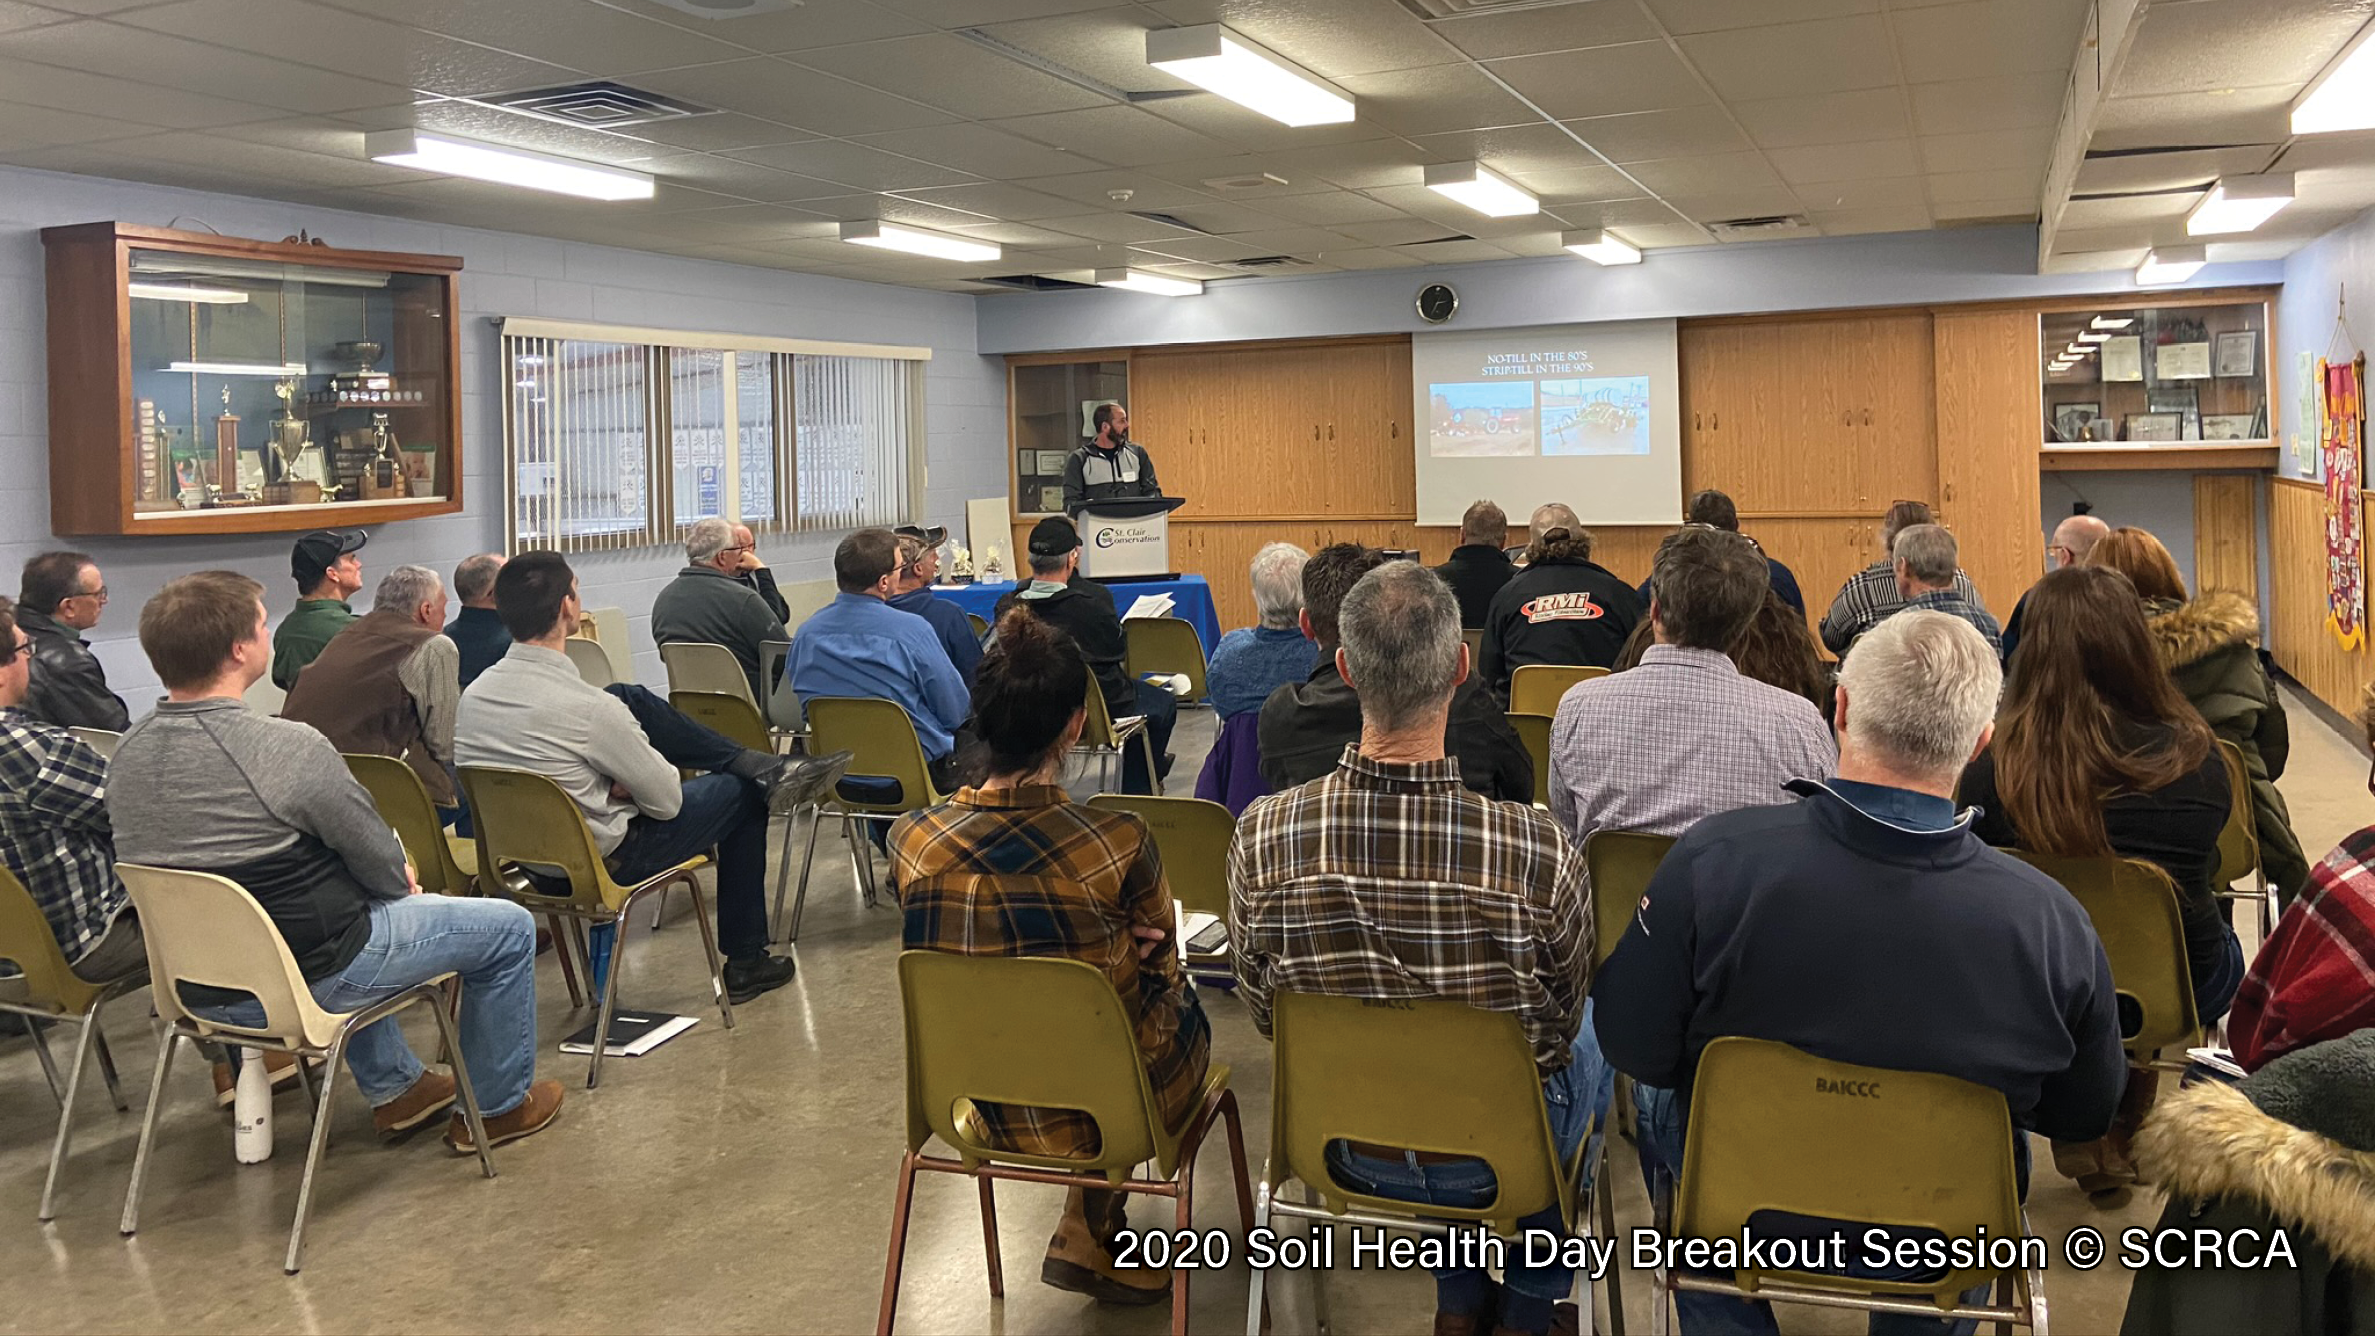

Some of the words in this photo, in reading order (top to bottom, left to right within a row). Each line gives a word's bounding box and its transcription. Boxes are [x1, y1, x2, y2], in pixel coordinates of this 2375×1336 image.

[1487, 353, 1527, 364] NO-TILL
[1530, 352, 1541, 362] IN
[1543, 351, 1565, 362] THE
[1567, 350, 1588, 361] 80'S
[1536, 363, 1547, 374] IN
[1549, 362, 1571, 374] THE
[1573, 361, 1594, 373] 90'S
[1115, 528, 1125, 537] St.
[1126, 527, 1146, 537] Clair
[1815, 1077, 1881, 1099] BAICCC
